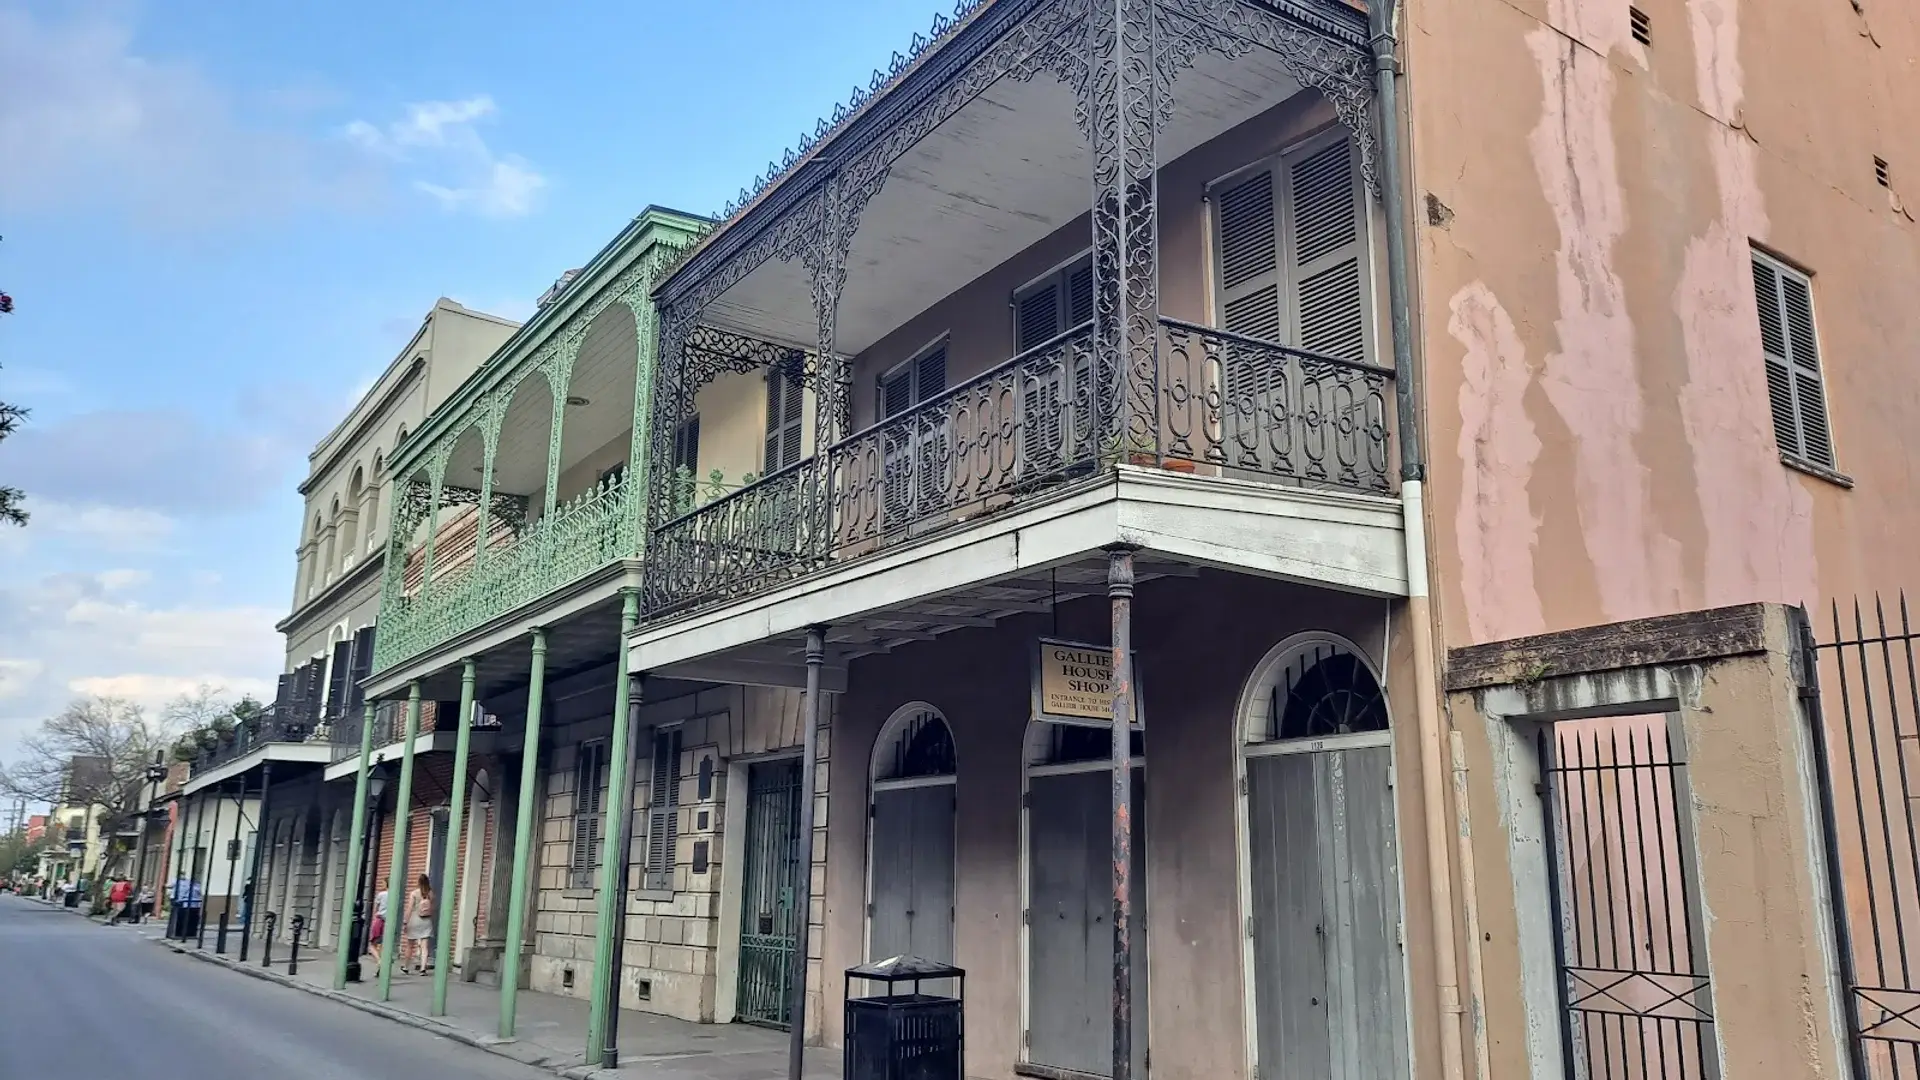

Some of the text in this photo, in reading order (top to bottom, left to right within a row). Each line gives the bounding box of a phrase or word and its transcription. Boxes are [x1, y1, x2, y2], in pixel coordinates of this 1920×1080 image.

[1068, 679, 1109, 694] SHOP
[1051, 693, 1084, 703] ENTRANCE
[1087, 697, 1097, 705] TO
[1051, 701, 1077, 709] GALLIER
